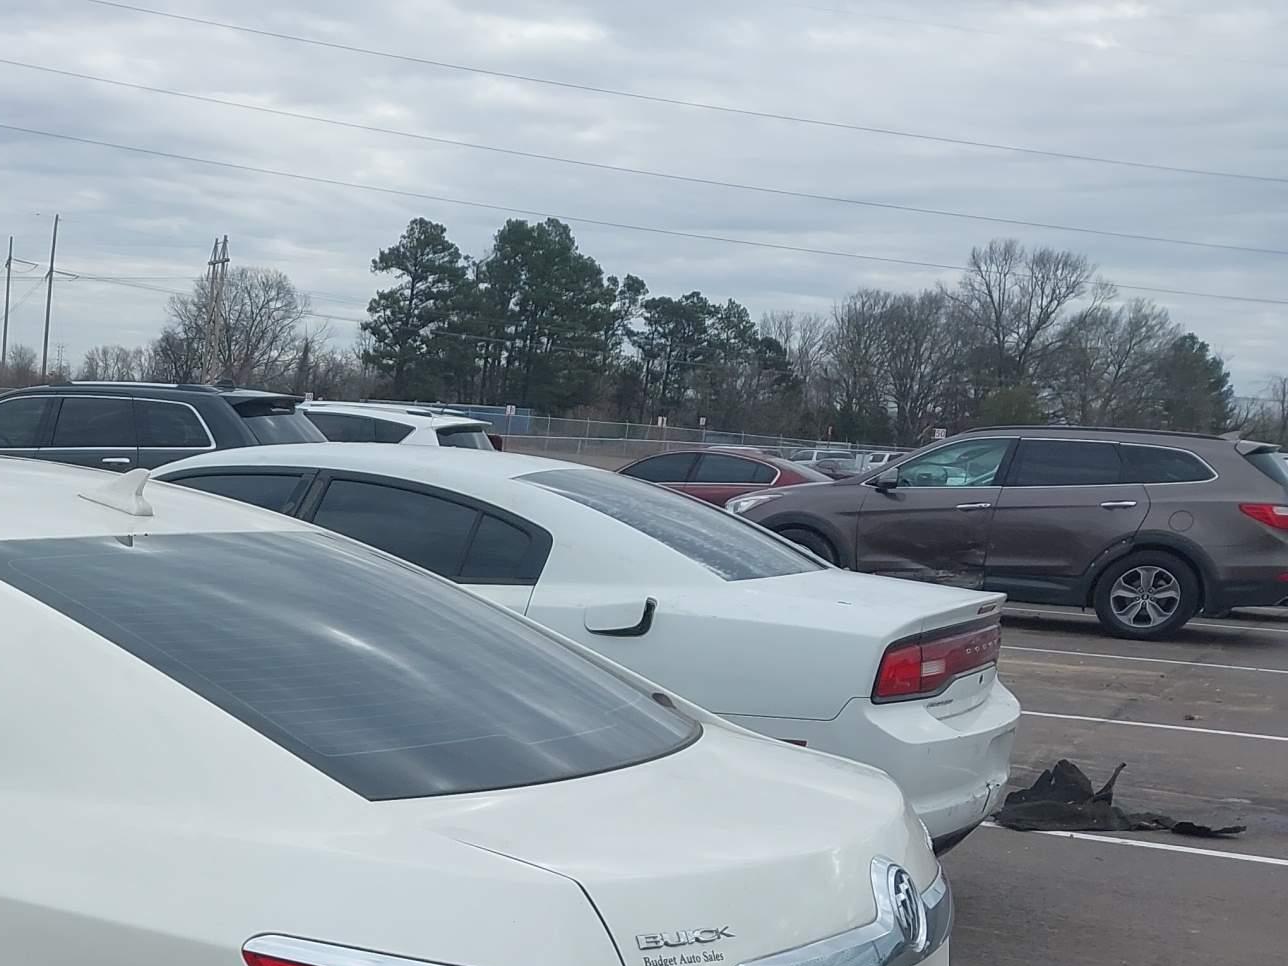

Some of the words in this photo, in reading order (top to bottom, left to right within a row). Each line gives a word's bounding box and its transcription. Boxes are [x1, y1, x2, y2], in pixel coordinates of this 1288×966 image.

[635, 926, 736, 950] BUICK
[679, 954, 702, 965] Auto
[702, 950, 724, 962] Sales
